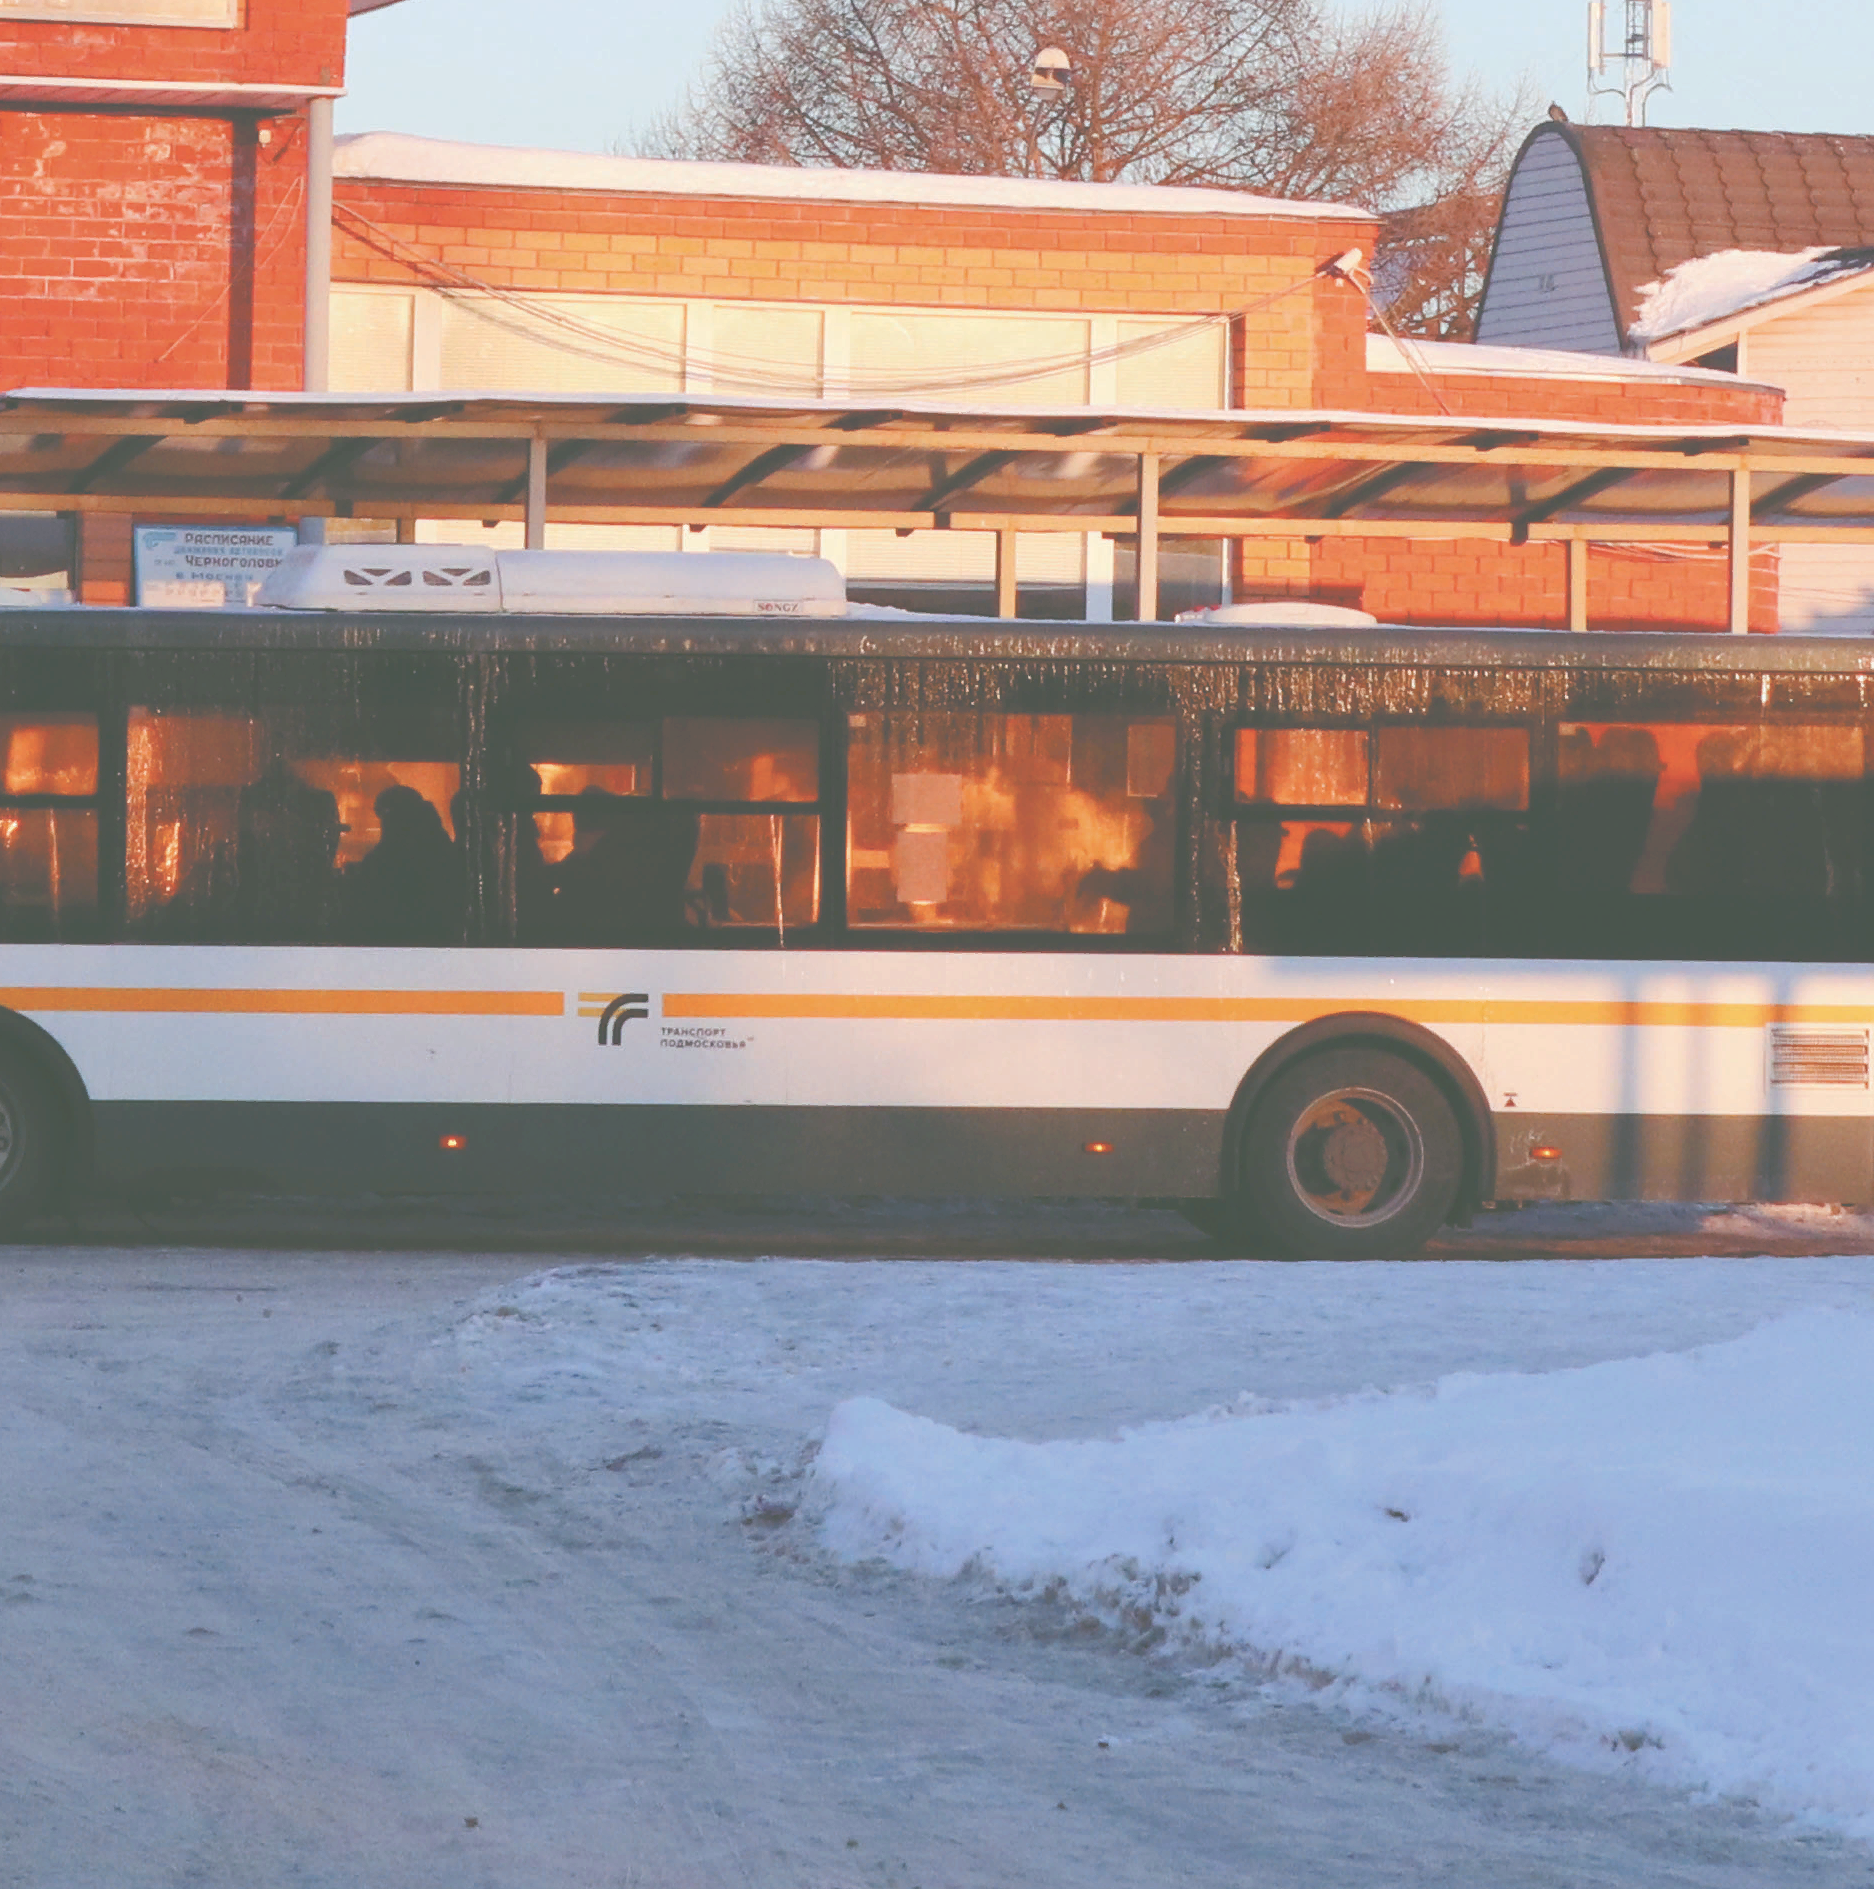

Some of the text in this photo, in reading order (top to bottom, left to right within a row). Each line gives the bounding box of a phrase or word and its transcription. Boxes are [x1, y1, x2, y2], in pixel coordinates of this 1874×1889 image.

[185, 532, 275, 546] РАСПИСАНИЕ
[185, 554, 283, 569] ЧЕРНОГОЛОВК
[661, 1026, 727, 1037] ТРАНСПОРТ
[660, 1038, 747, 1049] ПОДМОСКОВЬЯ
